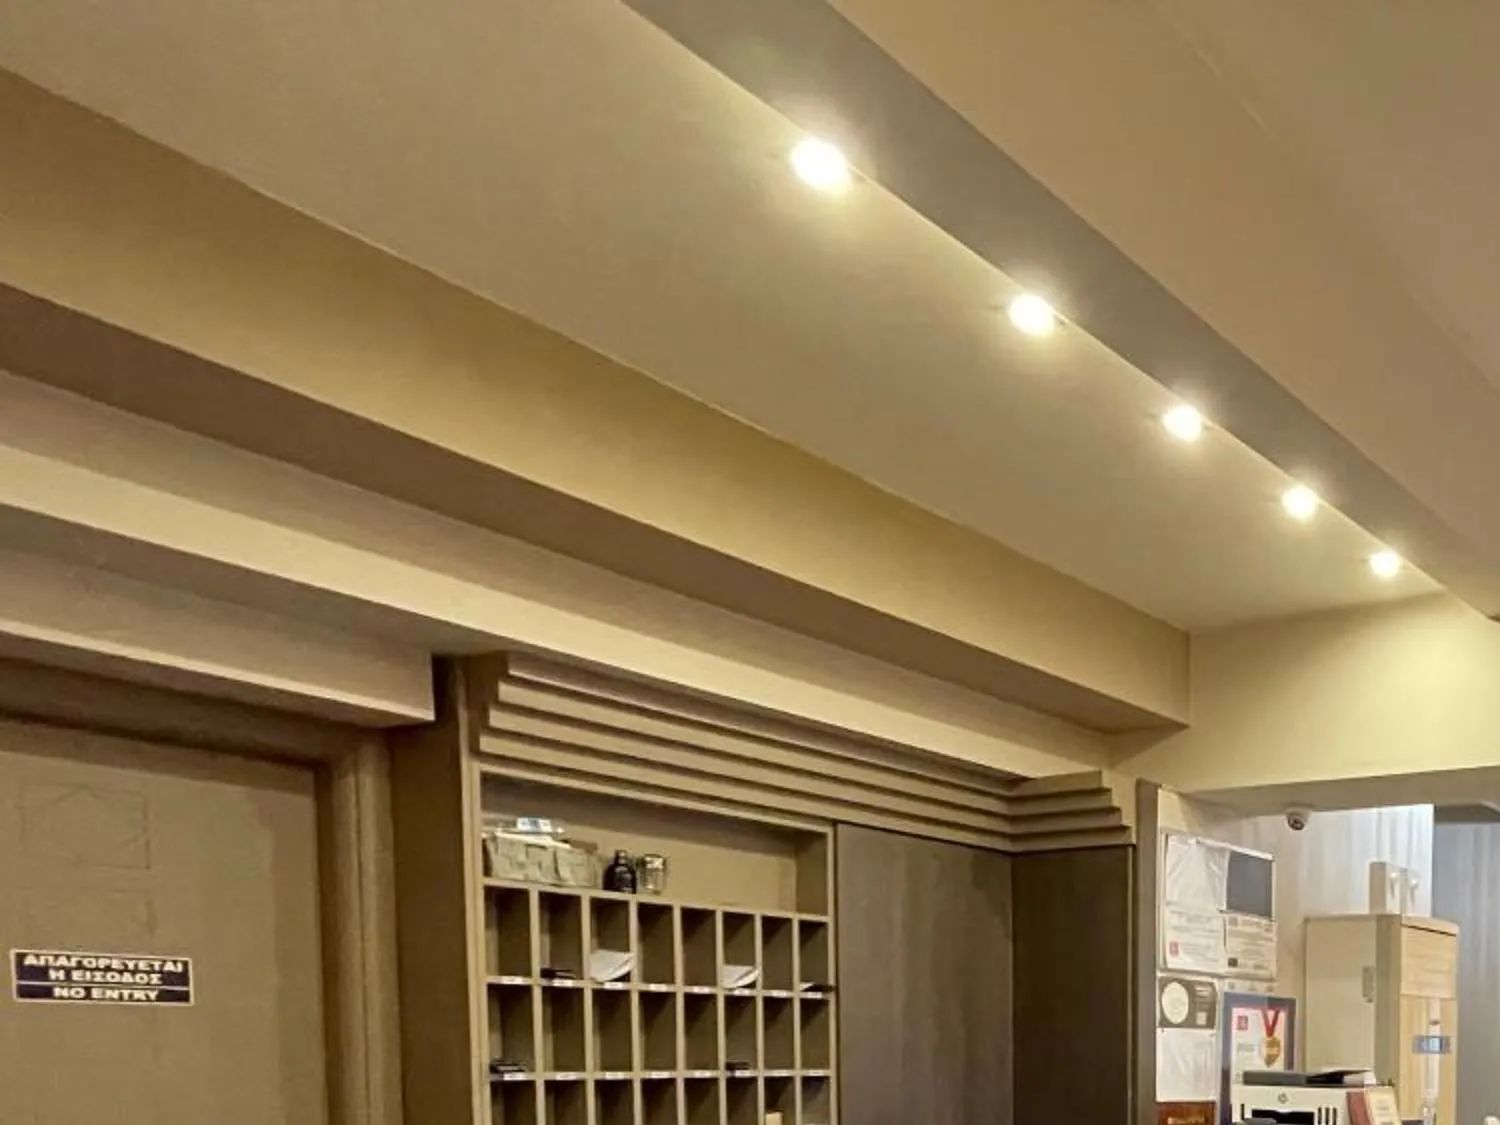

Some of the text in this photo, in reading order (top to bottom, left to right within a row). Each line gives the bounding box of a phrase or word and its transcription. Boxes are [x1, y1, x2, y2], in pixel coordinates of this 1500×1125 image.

[23, 954, 184, 973] ΑΠΑΓΟΡΕΥΕΤΑΙ
[50, 969, 163, 985] Η ΕΙΣΟΔΟΣ
[53, 987, 160, 1001] NO ENTRY
